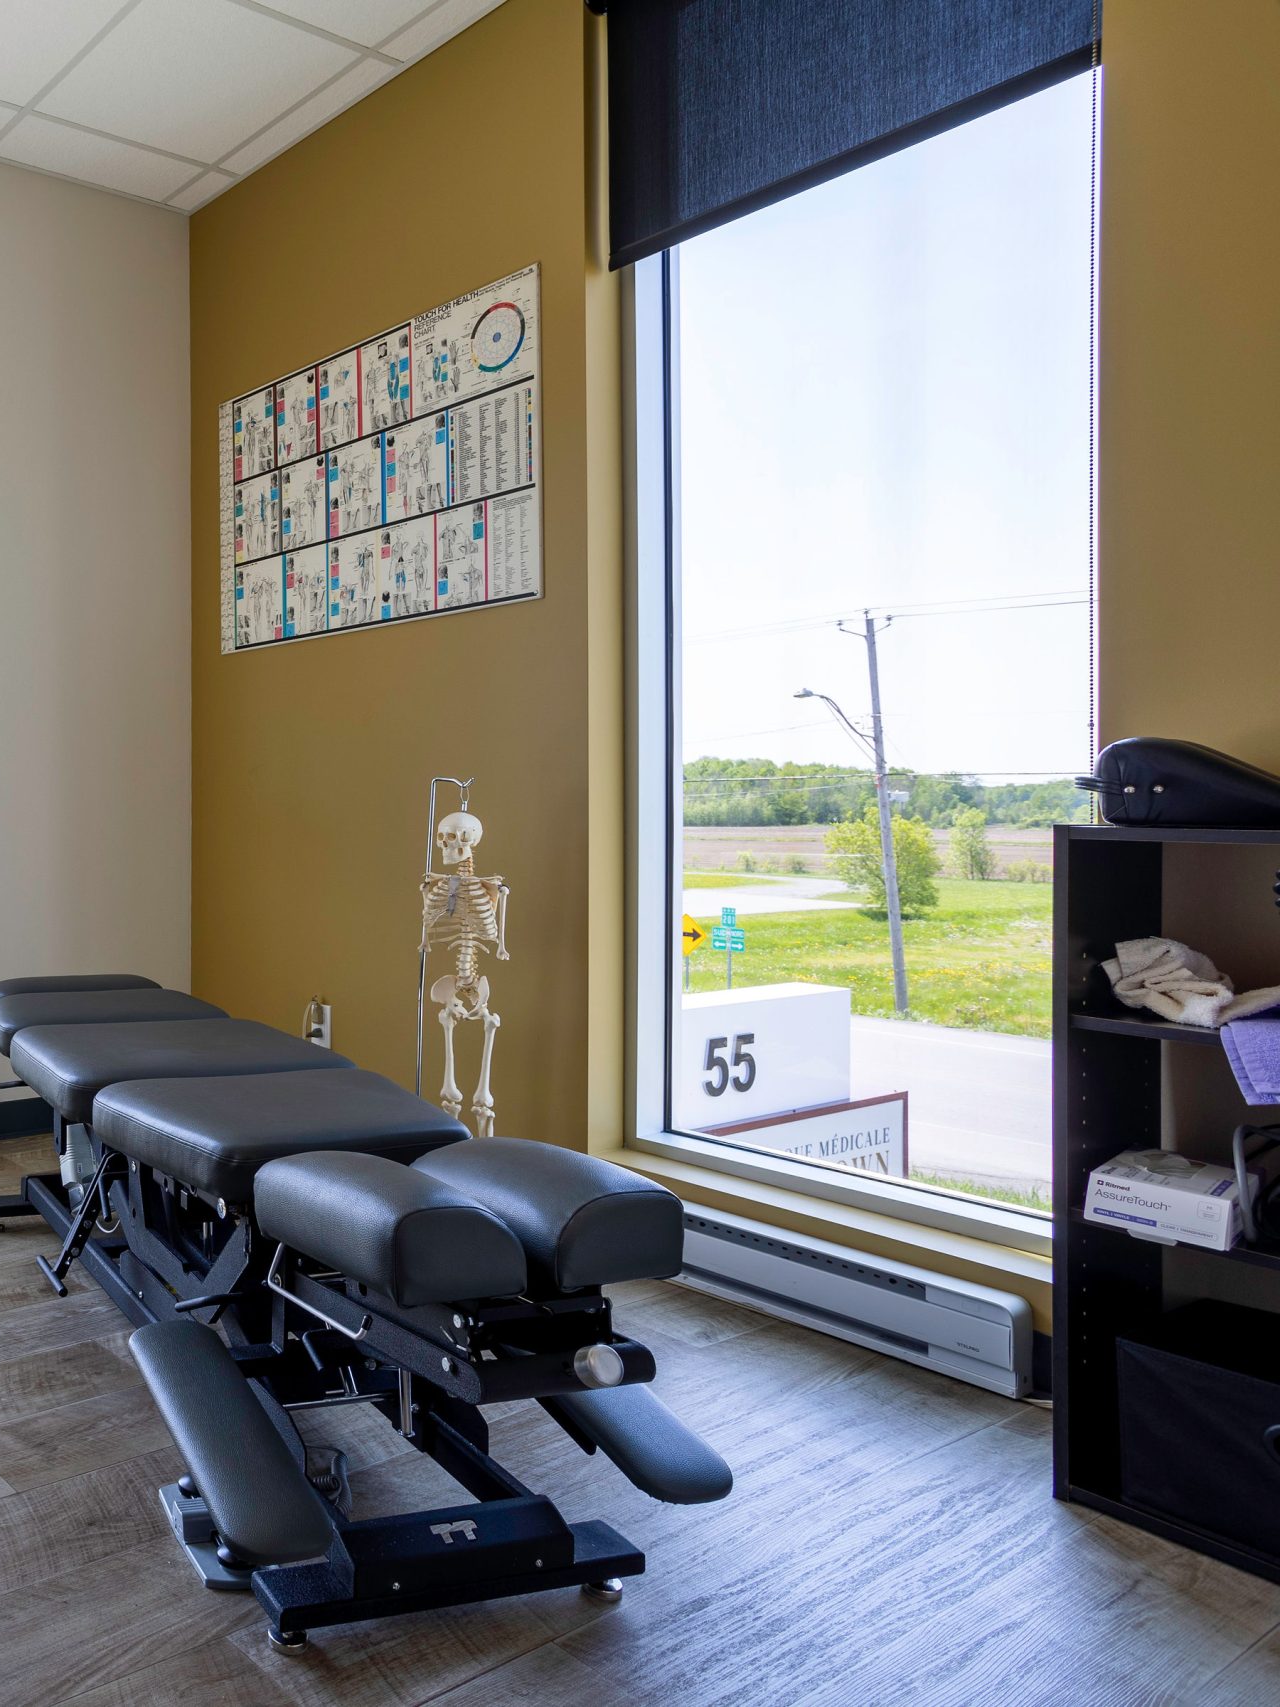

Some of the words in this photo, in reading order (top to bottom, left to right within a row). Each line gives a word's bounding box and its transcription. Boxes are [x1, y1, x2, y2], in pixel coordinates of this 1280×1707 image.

[414, 308, 437, 324] TOUCH
[438, 303, 452, 316] FOR
[453, 290, 479, 308] HEALTH
[414, 311, 452, 331] REFERENCE
[414, 325, 436, 339] CHART
[702, 1033, 756, 1097] 55
[819, 1127, 890, 1157] MÉDICALE
[1105, 1181, 1131, 1192] Ritmed
